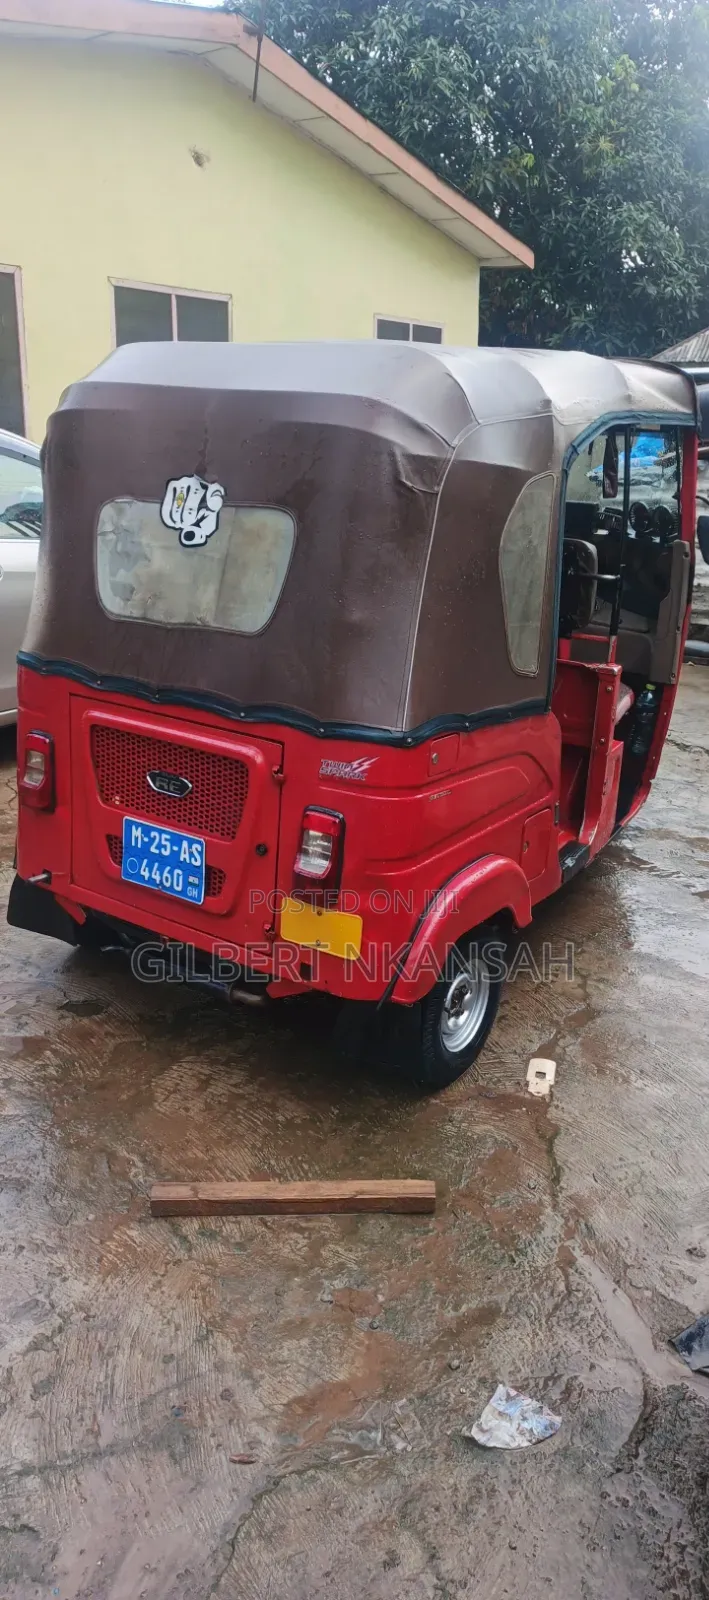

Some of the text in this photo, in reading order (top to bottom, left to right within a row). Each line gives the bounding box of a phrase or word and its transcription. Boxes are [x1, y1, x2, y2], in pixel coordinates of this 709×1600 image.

[155, 776, 181, 793] RE
[131, 825, 202, 866] M-25-AS
[140, 859, 183, 892] 4460
[187, 886, 198, 899] GH
